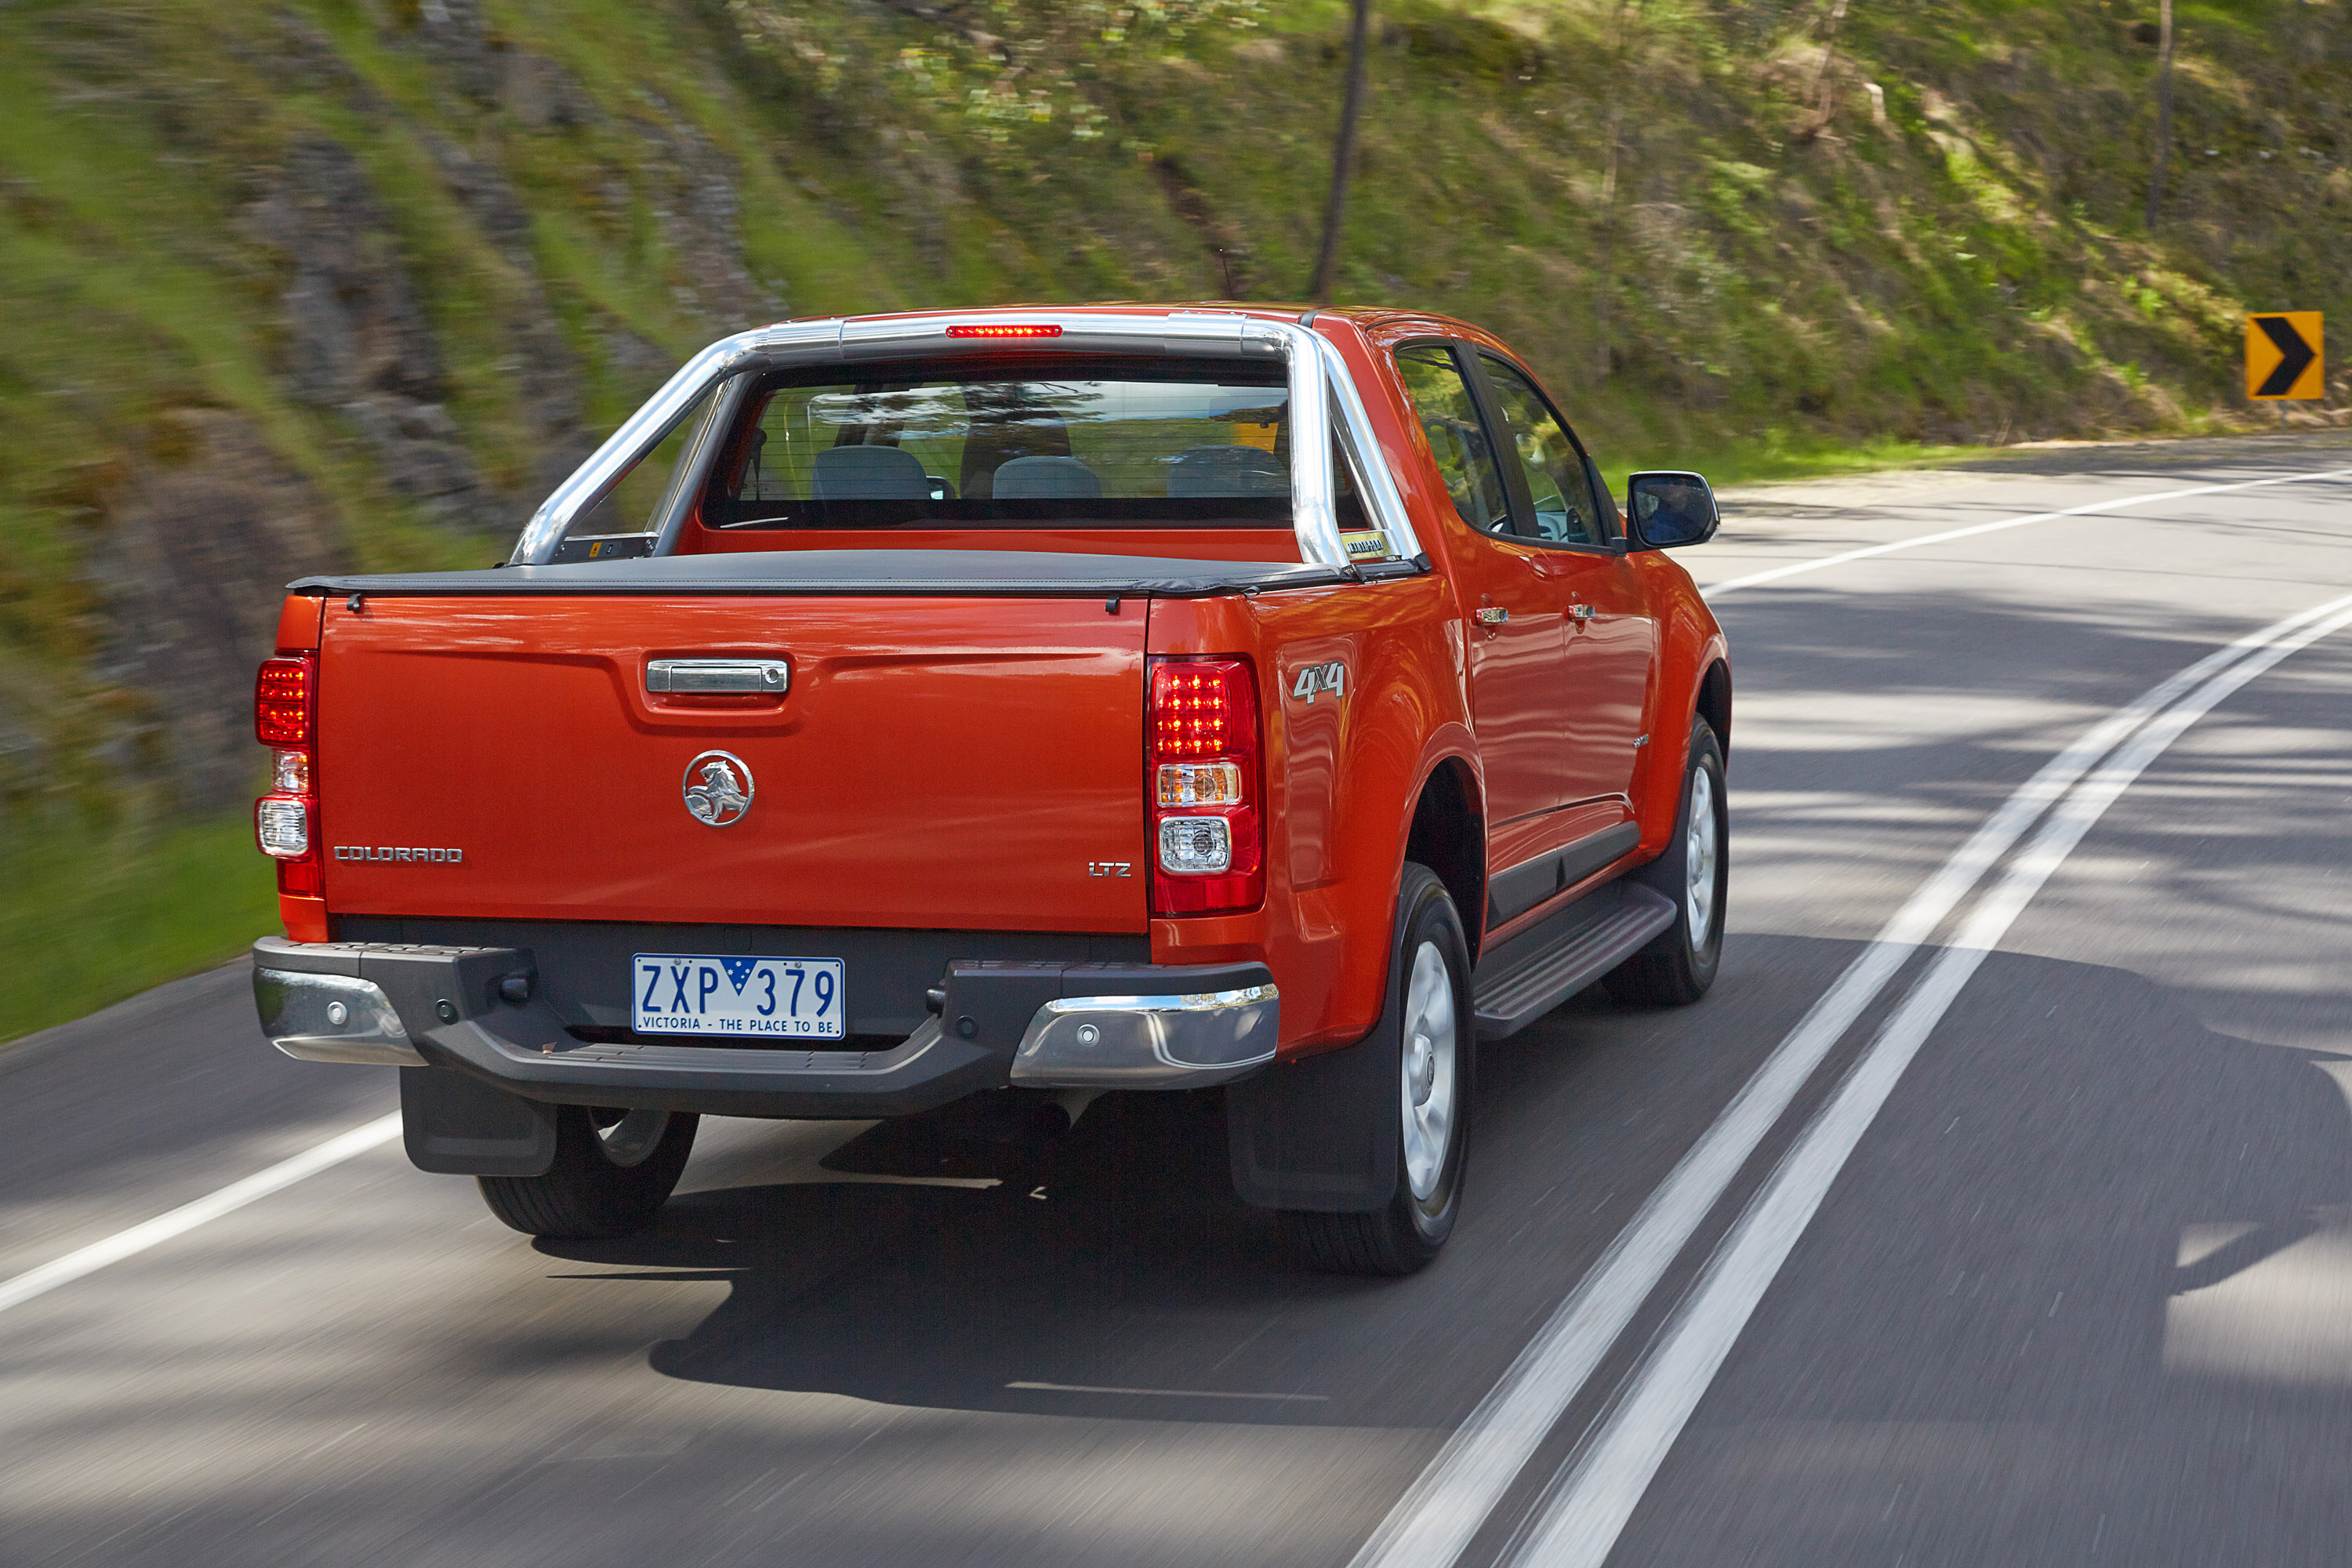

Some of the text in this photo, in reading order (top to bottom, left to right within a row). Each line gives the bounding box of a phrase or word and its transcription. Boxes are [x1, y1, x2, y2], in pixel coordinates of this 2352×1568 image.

[334, 846, 463, 863] COLORADO
[1089, 862, 1131, 877] LTZ
[642, 965, 835, 1018] ZXP 379
[643, 1017, 701, 1029] VICTORIA
[720, 1018, 742, 1031] THE
[750, 1020, 787, 1032] PLACE
[795, 1021, 811, 1033] TO
[818, 1022, 833, 1033] BE
